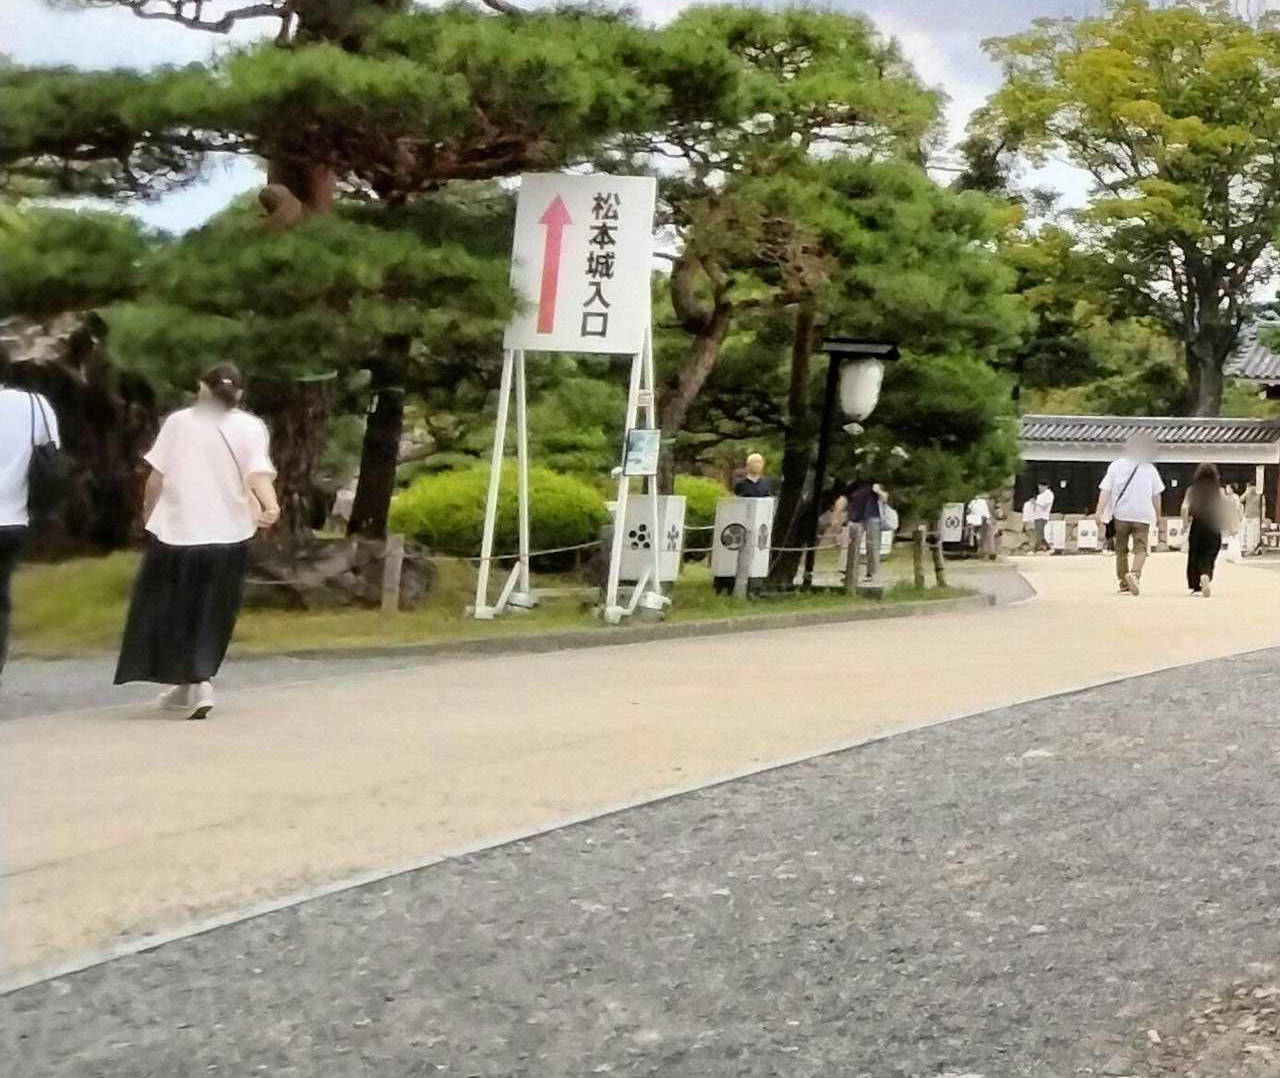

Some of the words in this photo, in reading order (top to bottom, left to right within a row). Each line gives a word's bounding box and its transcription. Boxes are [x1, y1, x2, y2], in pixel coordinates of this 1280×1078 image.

[580, 192, 621, 339] 松本城入口
